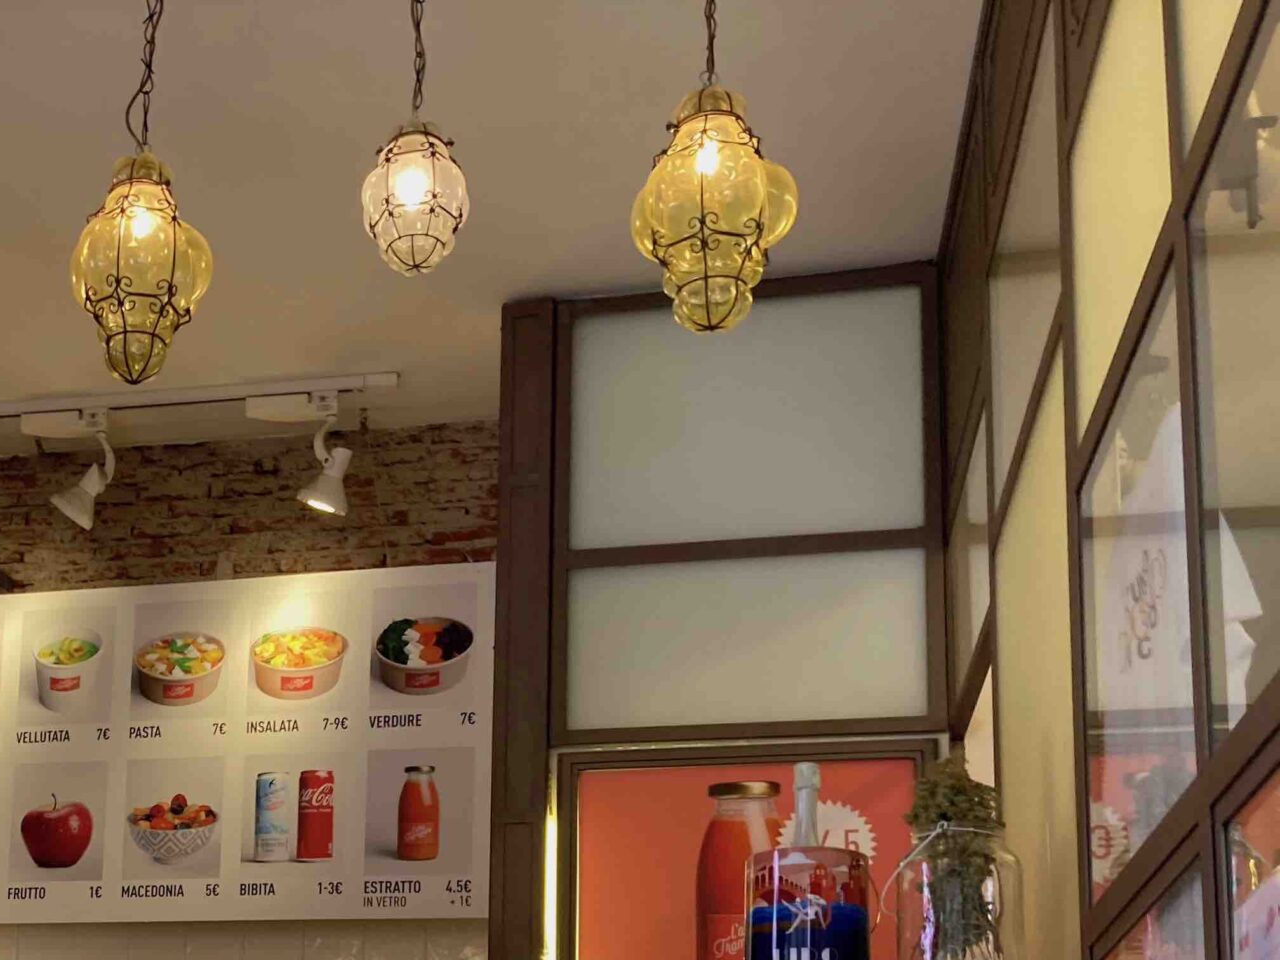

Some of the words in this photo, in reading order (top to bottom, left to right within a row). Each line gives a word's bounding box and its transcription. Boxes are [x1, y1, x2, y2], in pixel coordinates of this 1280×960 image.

[246, 719, 299, 734] INSALATA
[322, 717, 349, 730] 7-9€
[369, 714, 422, 728] VERDURE
[460, 712, 476, 725] 7€
[16, 729, 71, 744] VELLUTATA
[96, 728, 111, 741] 7€
[129, 726, 162, 739] PASTA
[213, 723, 227, 735] 7€
[7, 887, 46, 900] FRUTTO
[89, 885, 103, 898] 1€
[121, 885, 184, 898] MACEDONIA
[205, 883, 220, 896] 5€
[239, 882, 276, 896] BIBITA
[318, 881, 343, 895] 1-3€
[364, 880, 421, 894] ESTRATTO
[445, 880, 472, 893] 4.5€
[363, 896, 373, 908] IN
[376, 896, 407, 908] VETRO
